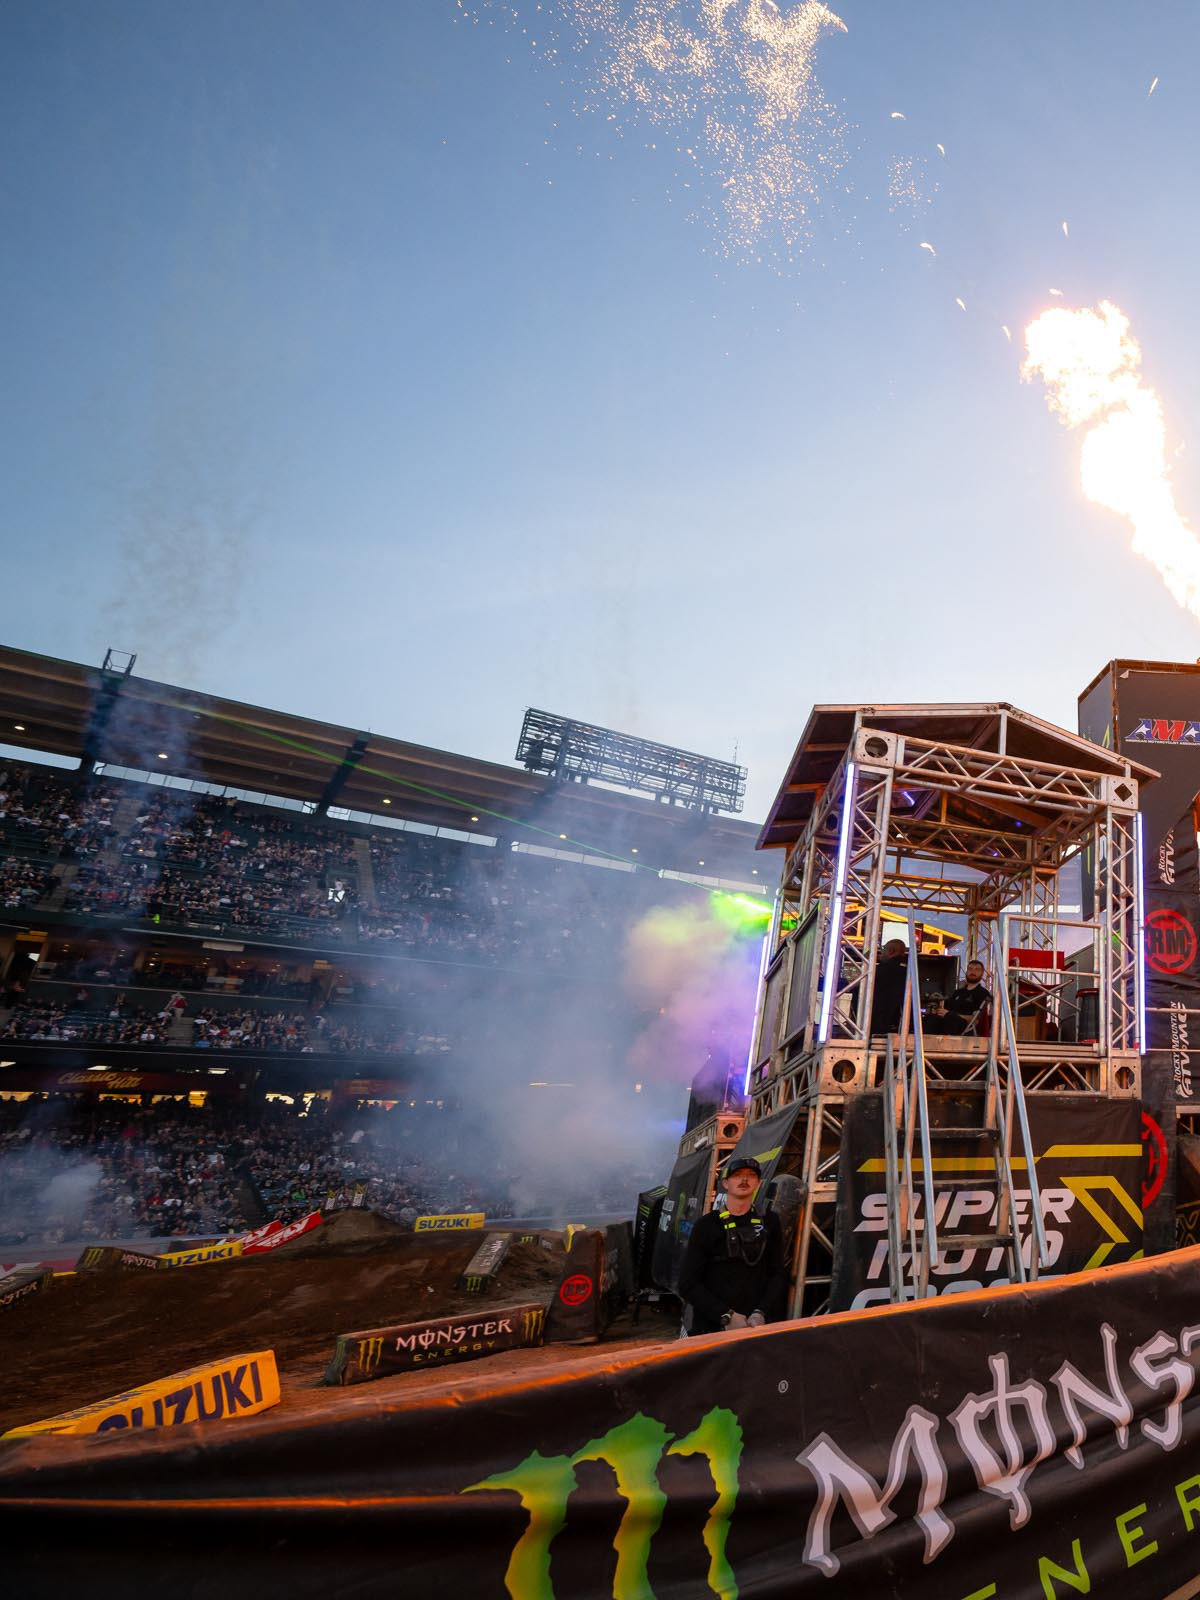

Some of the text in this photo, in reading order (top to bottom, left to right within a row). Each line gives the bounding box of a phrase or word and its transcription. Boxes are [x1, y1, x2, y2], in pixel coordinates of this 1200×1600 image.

[1170, 1001, 1182, 1082] ROCKY MOUNTAN
[418, 1217, 470, 1230] SUZUKI
[167, 1246, 233, 1268] UZUKI
[395, 1318, 513, 1352] MONSTER
[412, 1340, 497, 1362] ENERGY
